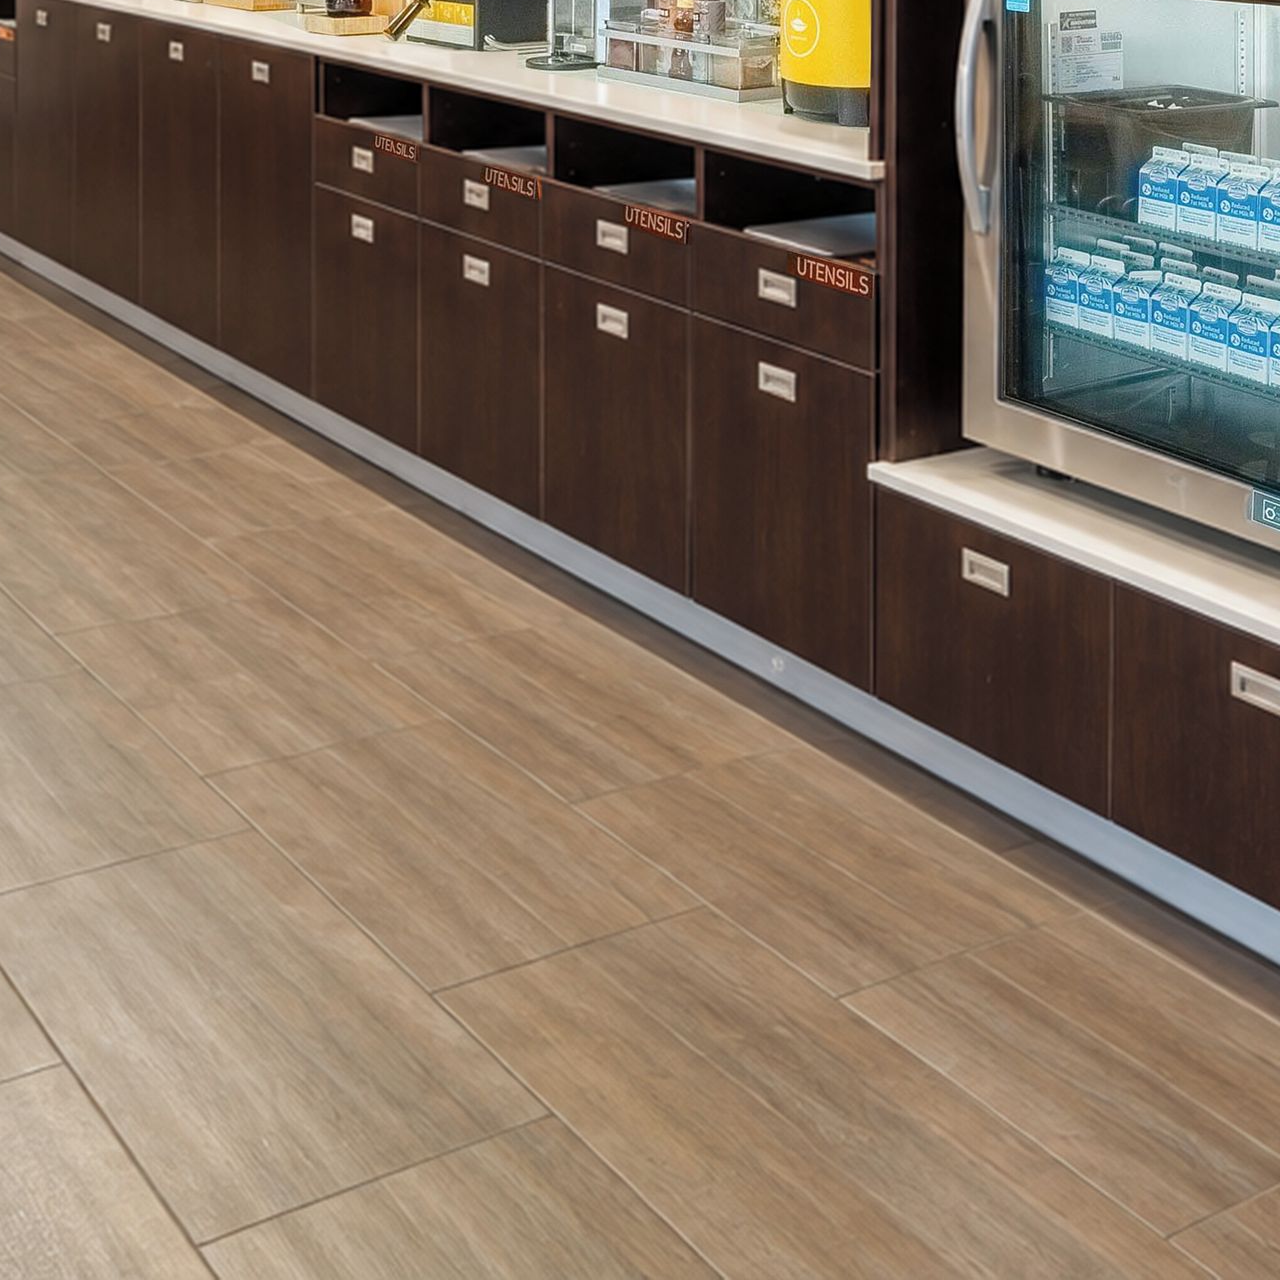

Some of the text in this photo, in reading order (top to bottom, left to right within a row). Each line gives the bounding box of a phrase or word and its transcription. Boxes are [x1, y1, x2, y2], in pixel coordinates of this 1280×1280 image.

[374, 135, 416, 160] UTENSILS
[484, 167, 535, 197] UTENSILS
[624, 205, 684, 240] UTENSILS
[796, 256, 870, 296] UTENSILS
